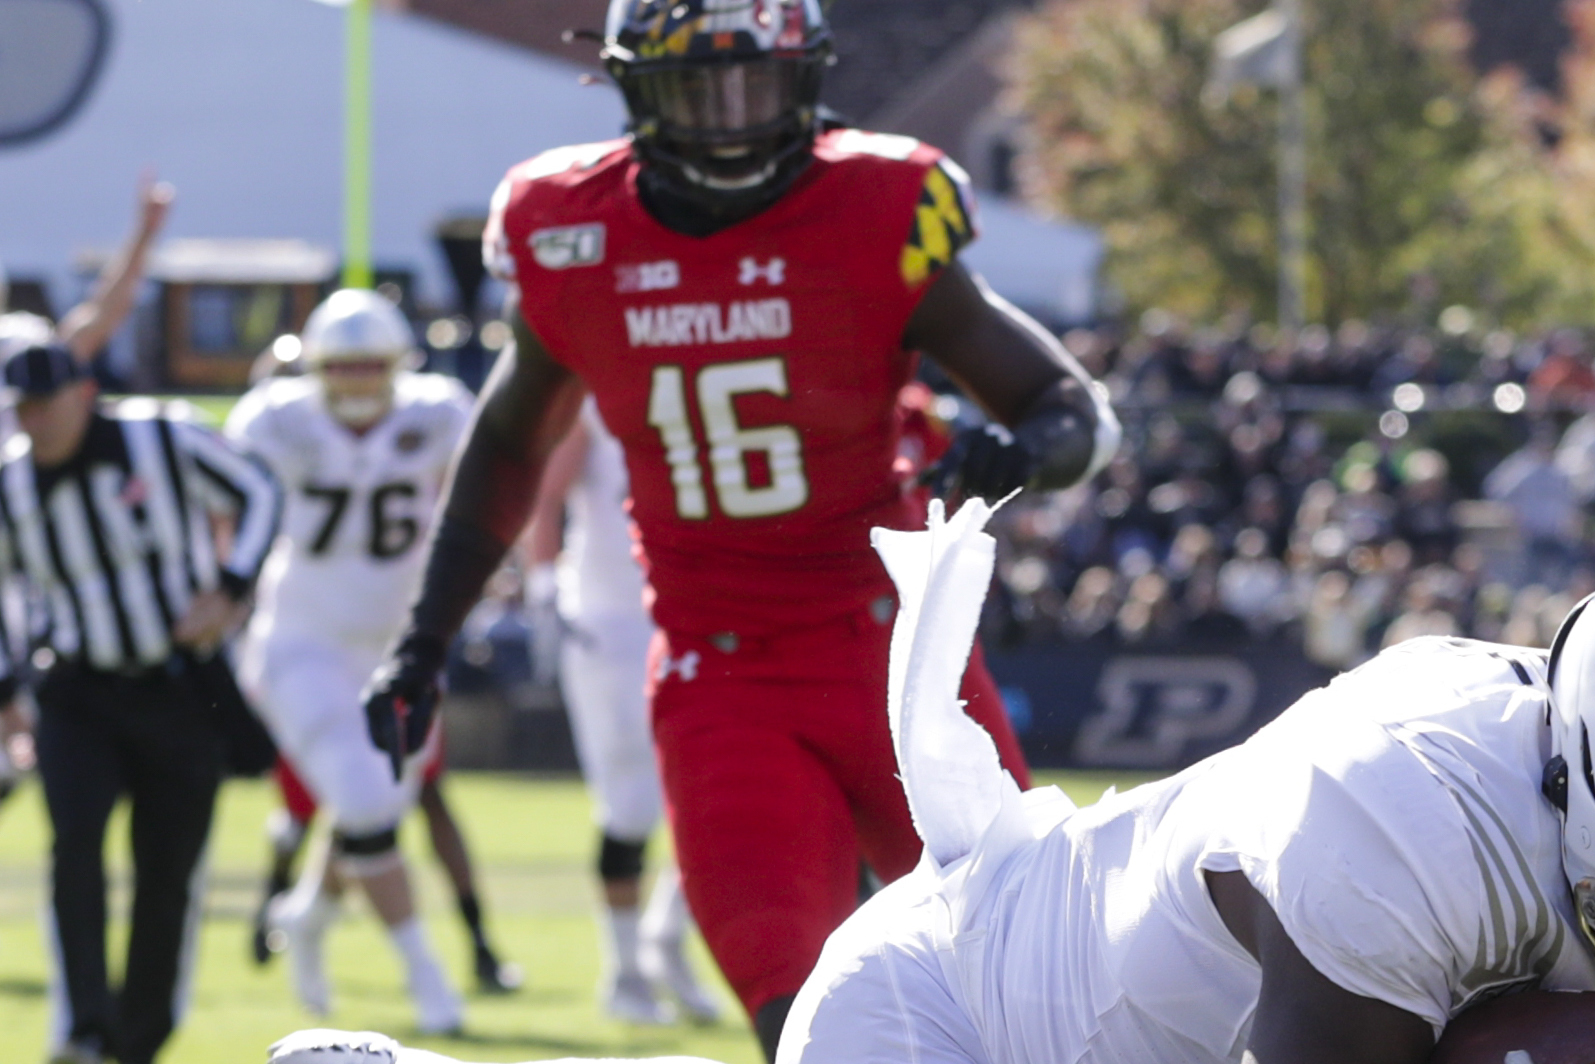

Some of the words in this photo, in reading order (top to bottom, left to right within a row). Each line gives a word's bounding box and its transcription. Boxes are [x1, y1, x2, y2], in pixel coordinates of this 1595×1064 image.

[624, 297, 791, 347] MARYLAND
[647, 357, 809, 519] 16
[303, 481, 420, 559] 76
[1075, 655, 1258, 768] P
